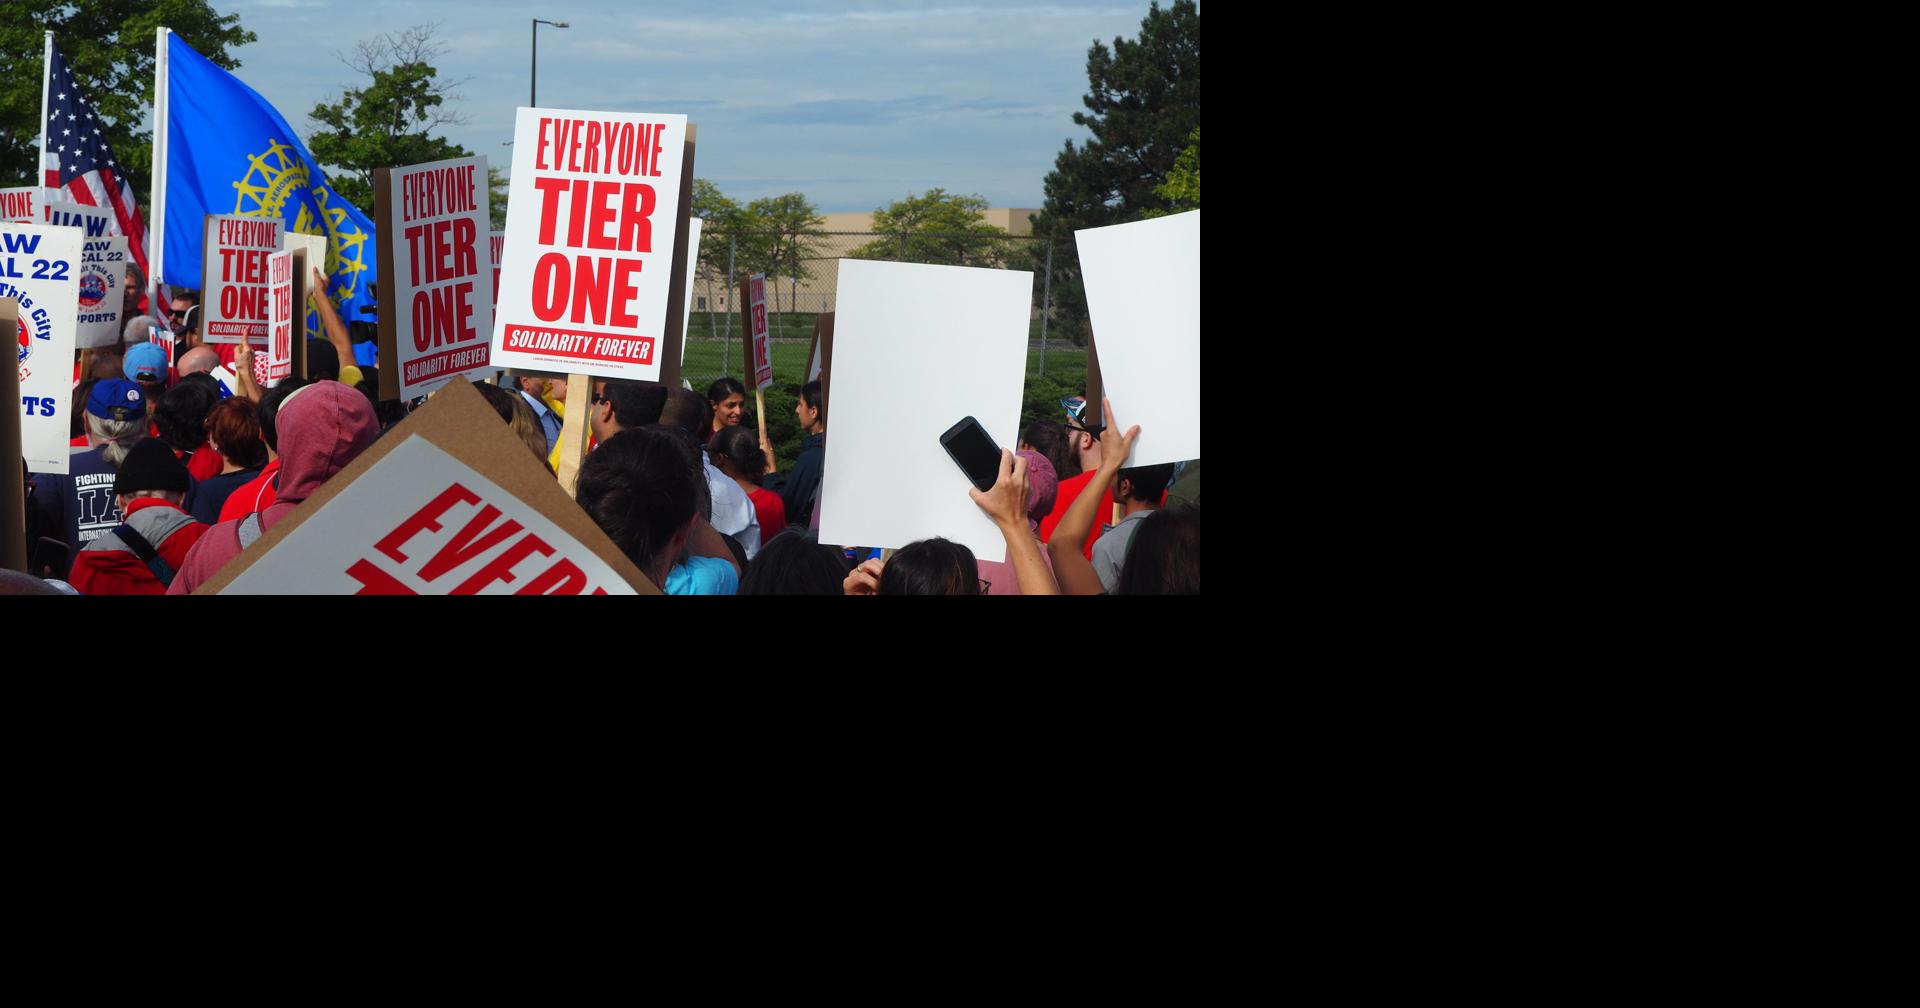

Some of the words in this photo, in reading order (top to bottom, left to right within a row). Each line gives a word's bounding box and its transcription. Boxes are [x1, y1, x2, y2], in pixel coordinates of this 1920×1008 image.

[536, 118, 665, 177] EVERYONE
[403, 165, 477, 222] EVERYONE
[534, 177, 657, 253] TIER
[219, 219, 277, 249] EVERYONE
[31, 258, 70, 281] 22
[106, 251, 123, 262] 22
[405, 217, 478, 287] TIER
[220, 285, 268, 320] ONE
[531, 252, 643, 328] ONE
[31, 308, 52, 341] City
[211, 323, 250, 334] SOLIDARITY
[412, 281, 477, 352] ONE
[509, 329, 592, 354] SOLIDARITY
[593, 337, 651, 360] FOREVER
[406, 356, 449, 382] SOLIDARITY
[449, 347, 488, 368] FOREVER
